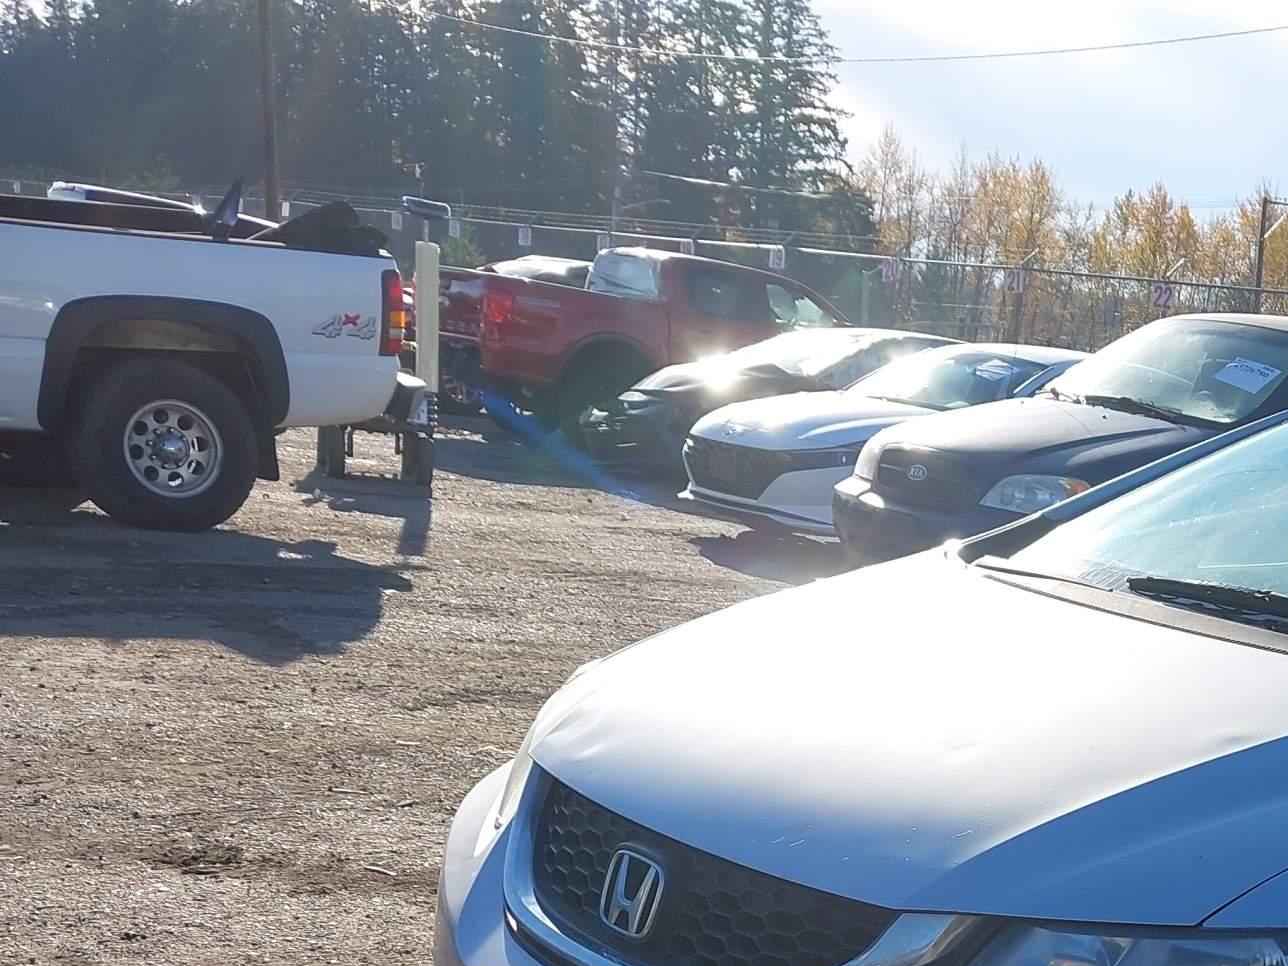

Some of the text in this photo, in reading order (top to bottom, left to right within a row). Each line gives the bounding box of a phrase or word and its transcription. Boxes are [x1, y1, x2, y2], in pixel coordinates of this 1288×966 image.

[884, 260, 897, 280] 20
[1007, 270, 1020, 290] 21
[1153, 285, 1171, 309] 22
